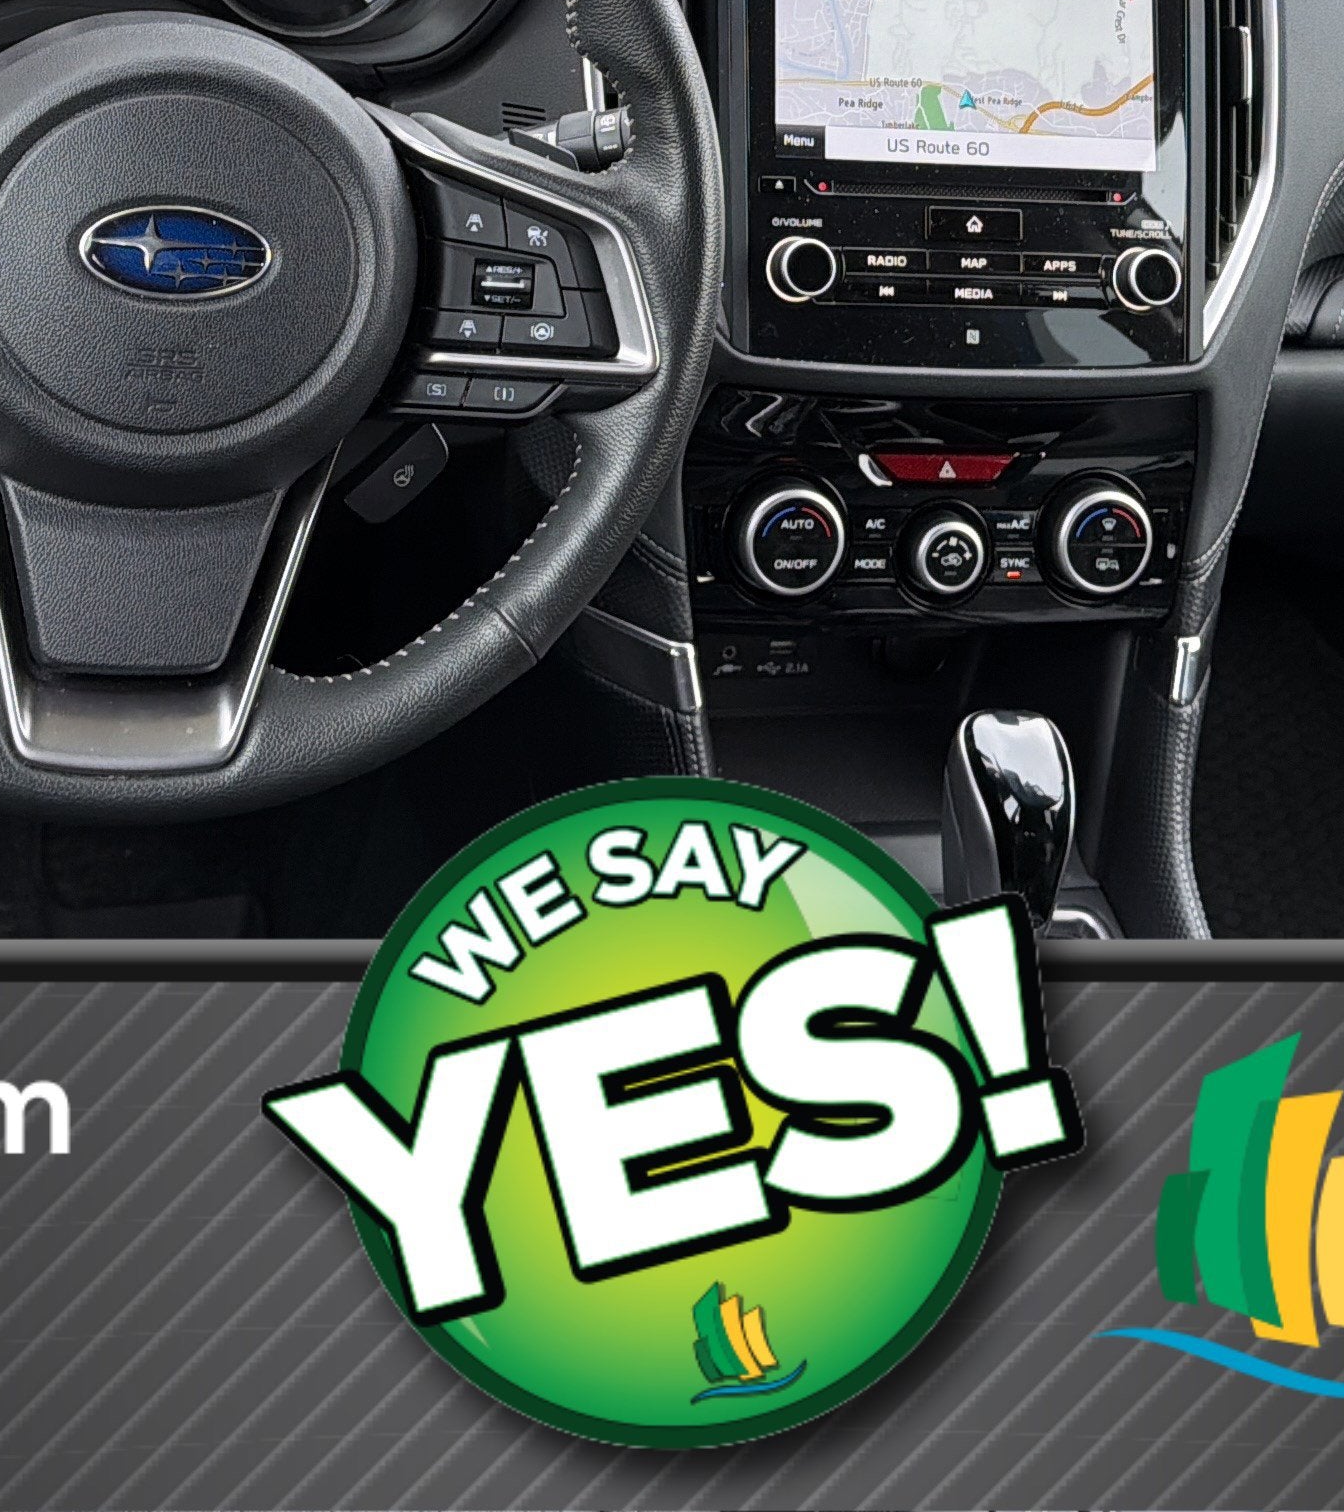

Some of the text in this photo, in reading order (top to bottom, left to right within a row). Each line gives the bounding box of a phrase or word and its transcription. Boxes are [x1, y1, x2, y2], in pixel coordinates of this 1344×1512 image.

[869, 77, 923, 88] US Route 60
[838, 97, 884, 110] Pea Ridge
[783, 133, 815, 147] Menu
[887, 137, 990, 156] US Route 60
[867, 254, 907, 267] RADIO
[960, 257, 988, 269] MAP
[1043, 260, 1077, 272] APPS
[954, 288, 993, 300] MEDIA
[780, 517, 815, 532] AUTO
[865, 518, 886, 530] A/C
[773, 557, 819, 573] ON/OFF
[854, 558, 887, 570] MODE
[1000, 557, 1031, 569] SYNC
